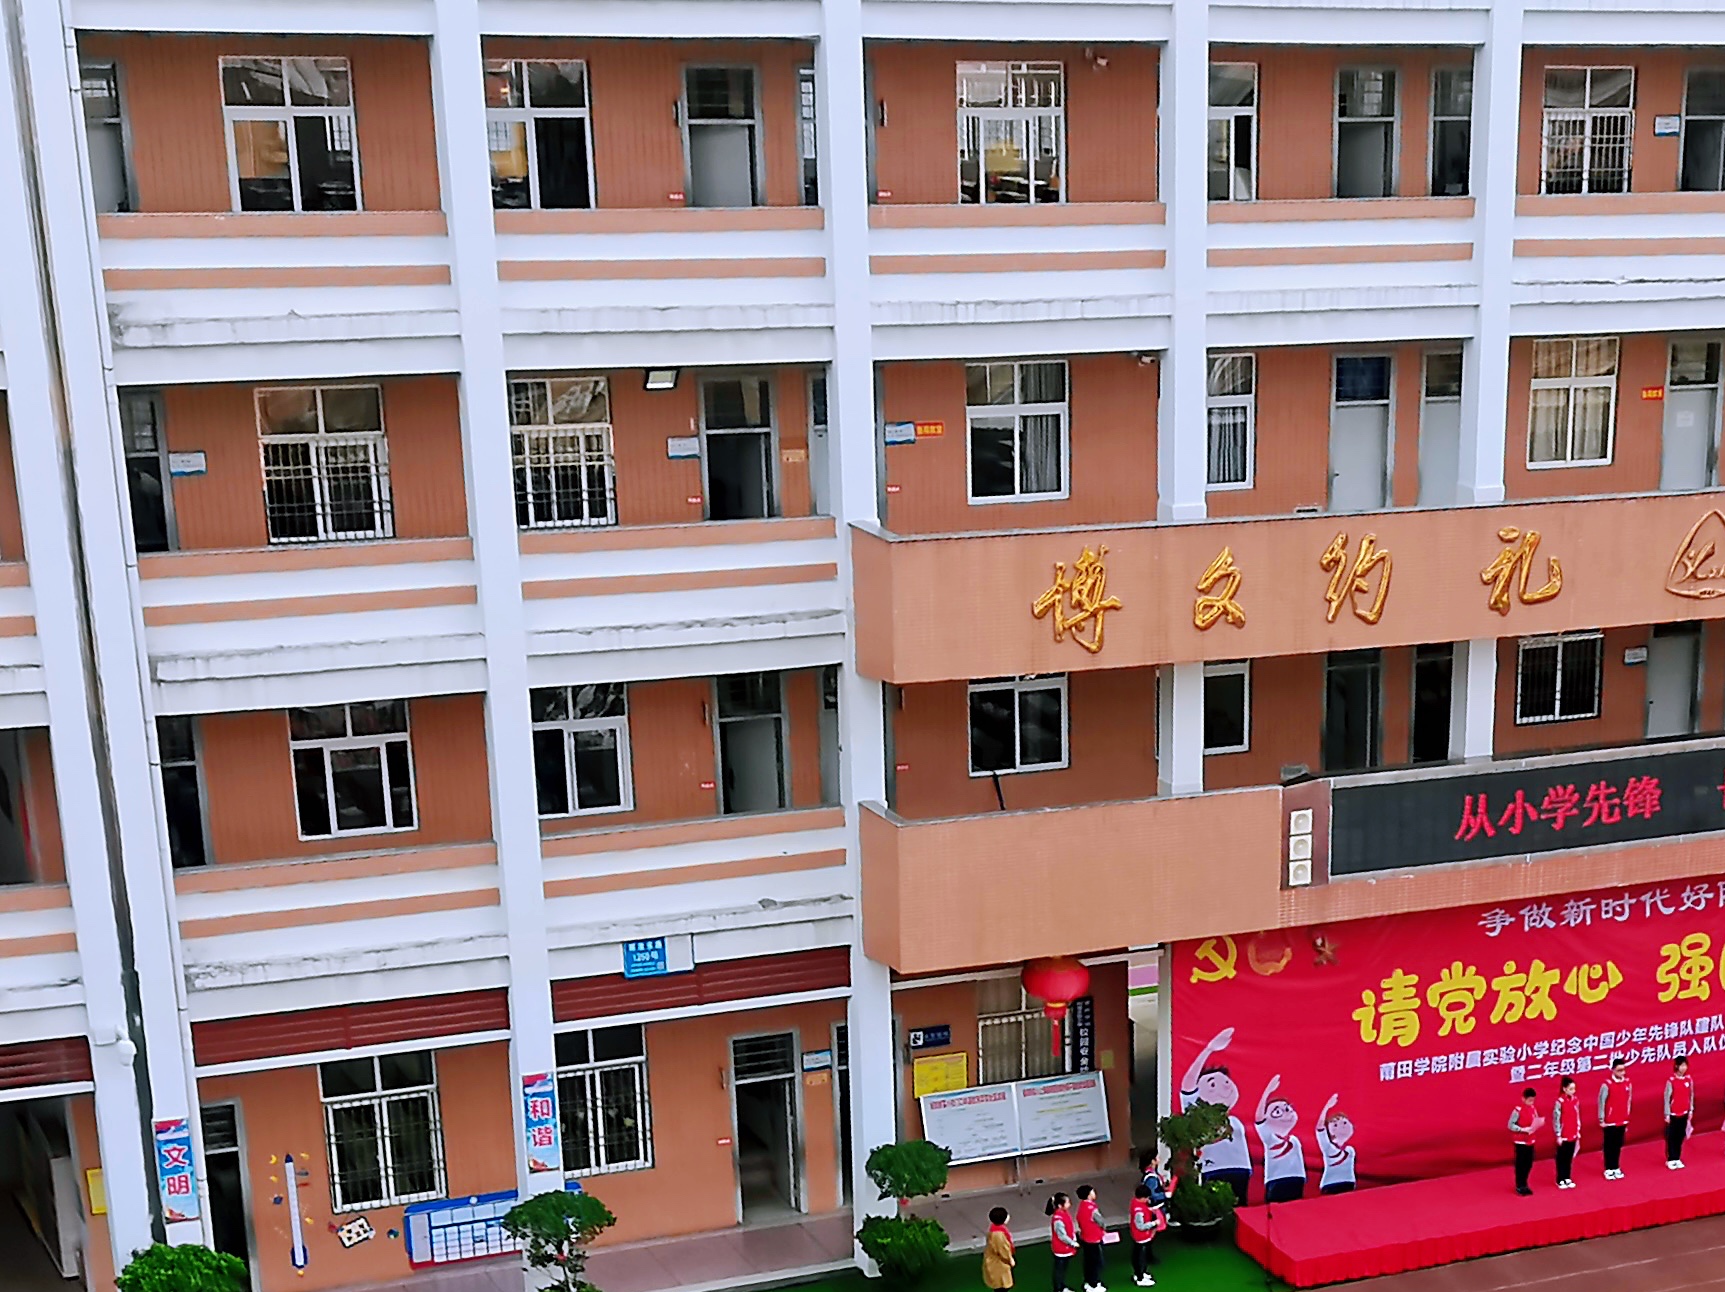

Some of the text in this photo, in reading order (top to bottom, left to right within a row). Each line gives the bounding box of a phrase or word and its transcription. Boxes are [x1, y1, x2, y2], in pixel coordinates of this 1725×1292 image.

[1033, 526, 1562, 652] 博文约礼
[1454, 775, 1663, 842] 从小学先锋
[1352, 959, 1624, 1047] 请党放心
[529, 1097, 555, 1149] 和谐
[161, 1143, 193, 1197] 文明
